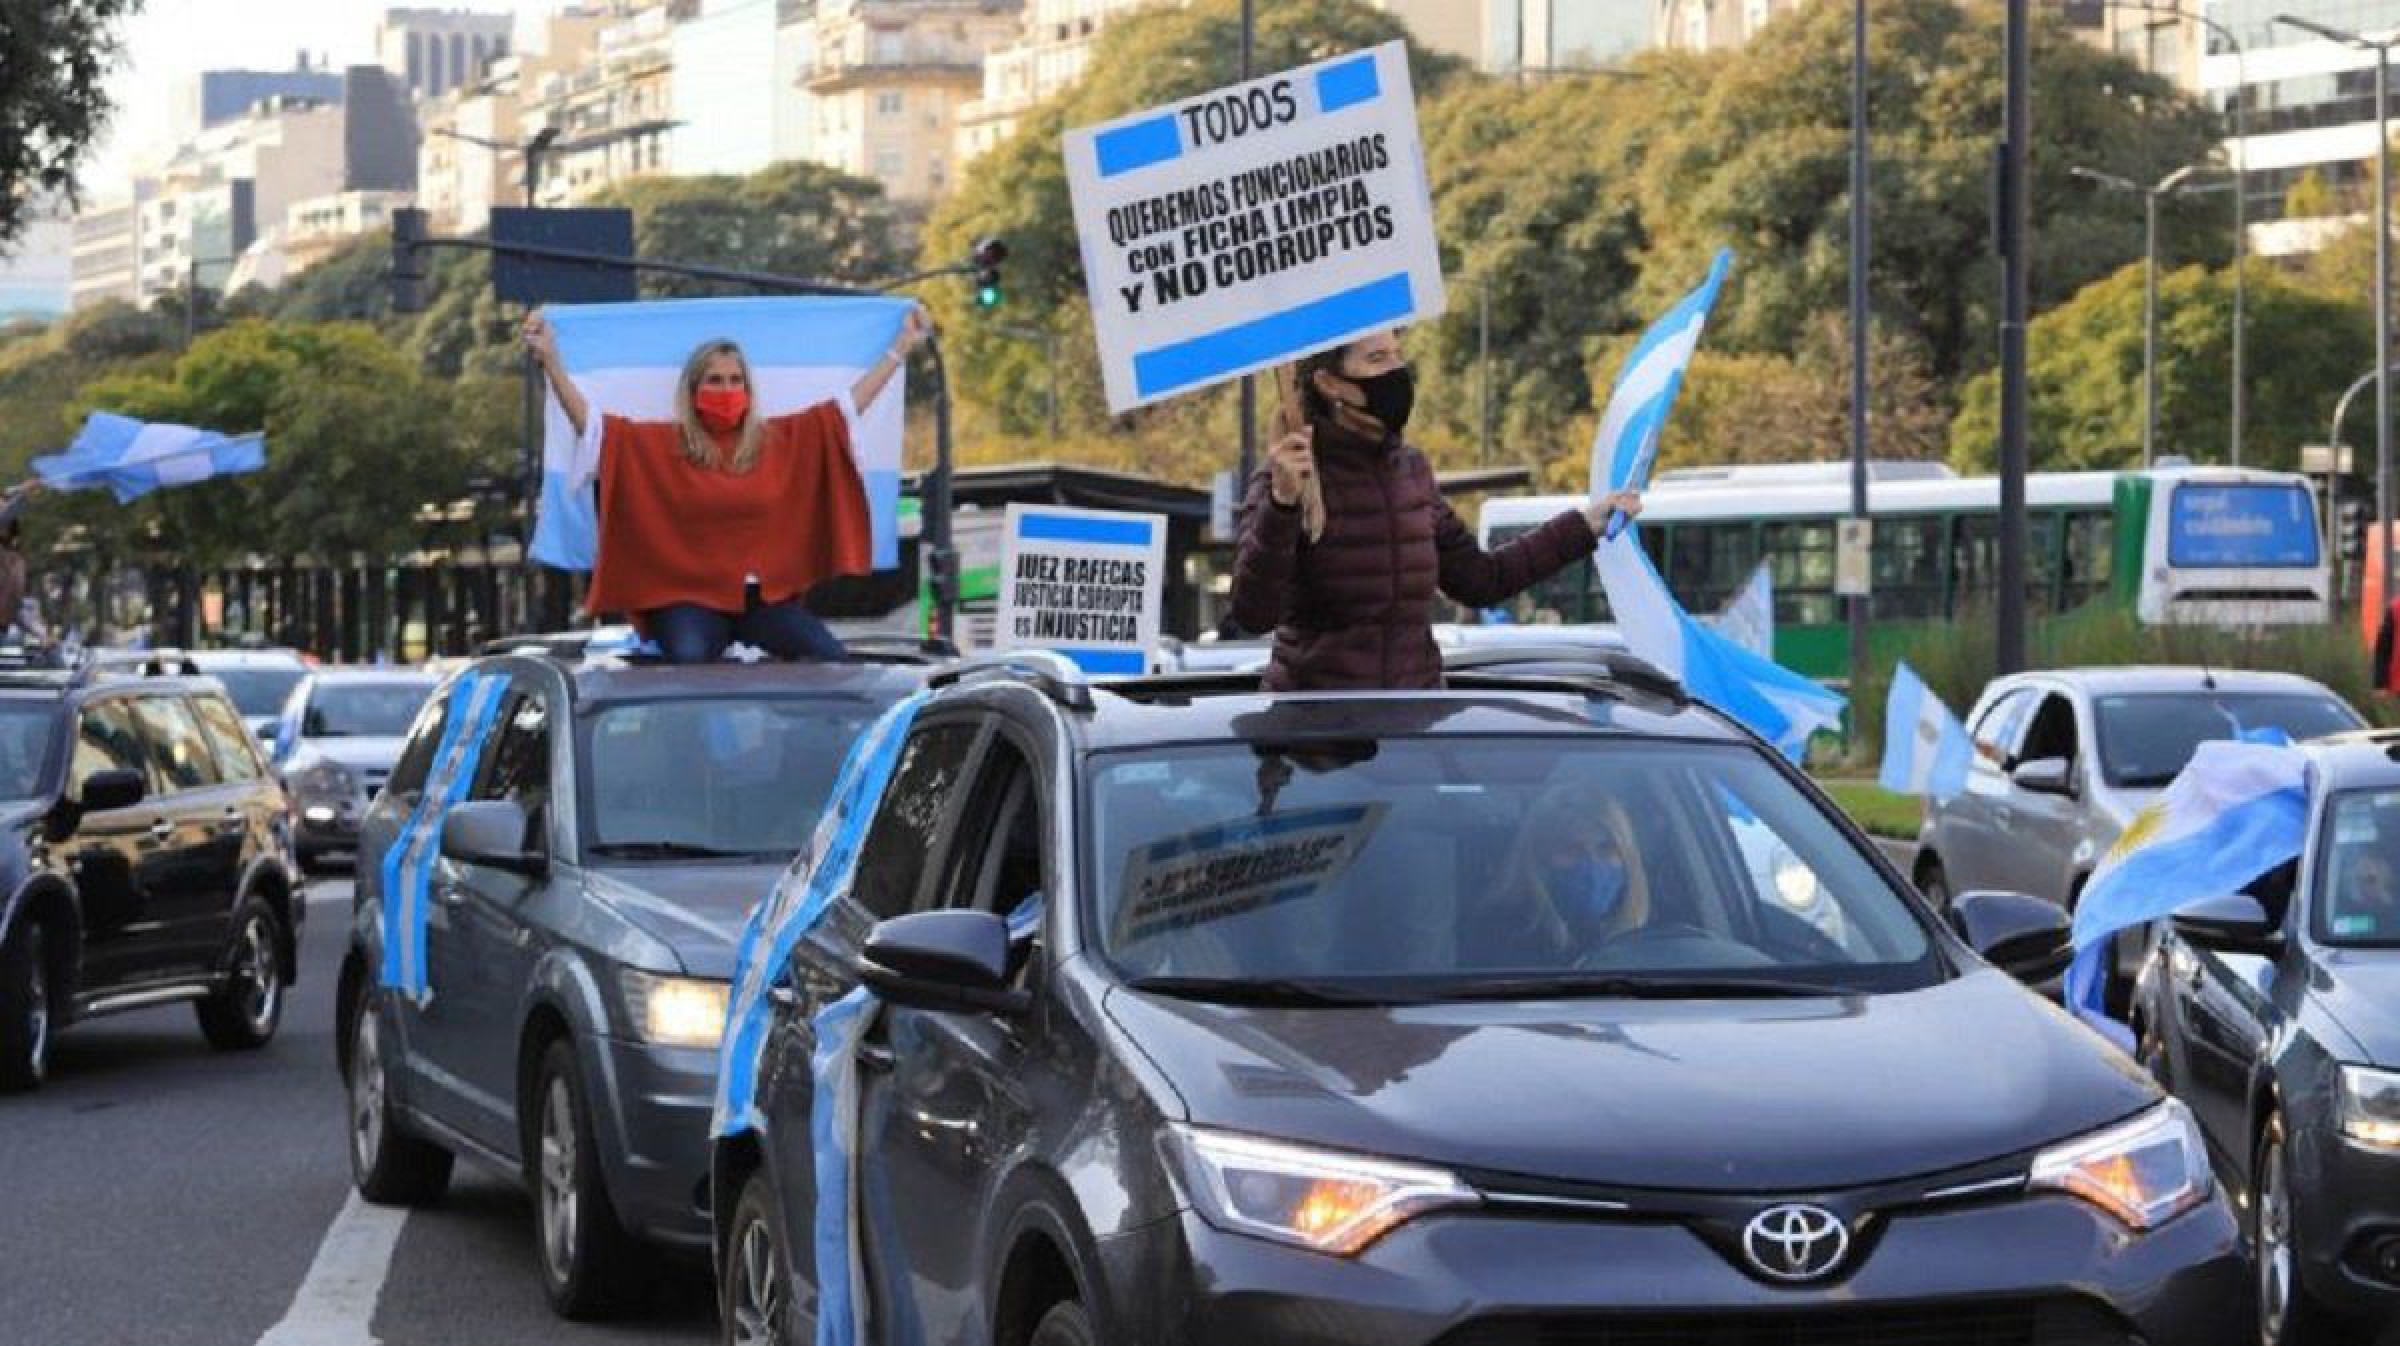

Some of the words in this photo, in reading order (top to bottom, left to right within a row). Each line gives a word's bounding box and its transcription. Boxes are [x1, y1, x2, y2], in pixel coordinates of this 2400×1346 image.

[1183, 80, 1297, 146] TODOS
[1108, 181, 1228, 247] QUEREMOS
[1232, 133, 1390, 206] FUNCIONARIOS
[1128, 241, 1176, 273] CON
[1183, 209, 1269, 258] FICHA
[1274, 179, 1370, 233] LIMPIA
[1120, 283, 1144, 313] Y
[1153, 262, 1207, 304] NO
[1214, 206, 1394, 288] CORRUPTOS
[1014, 582, 1073, 608] JUSTICIA
[1016, 554, 1059, 582] JUEZ
[1064, 558, 1145, 586] RAFECAS
[1034, 609, 1137, 641] INJUSTICIA
